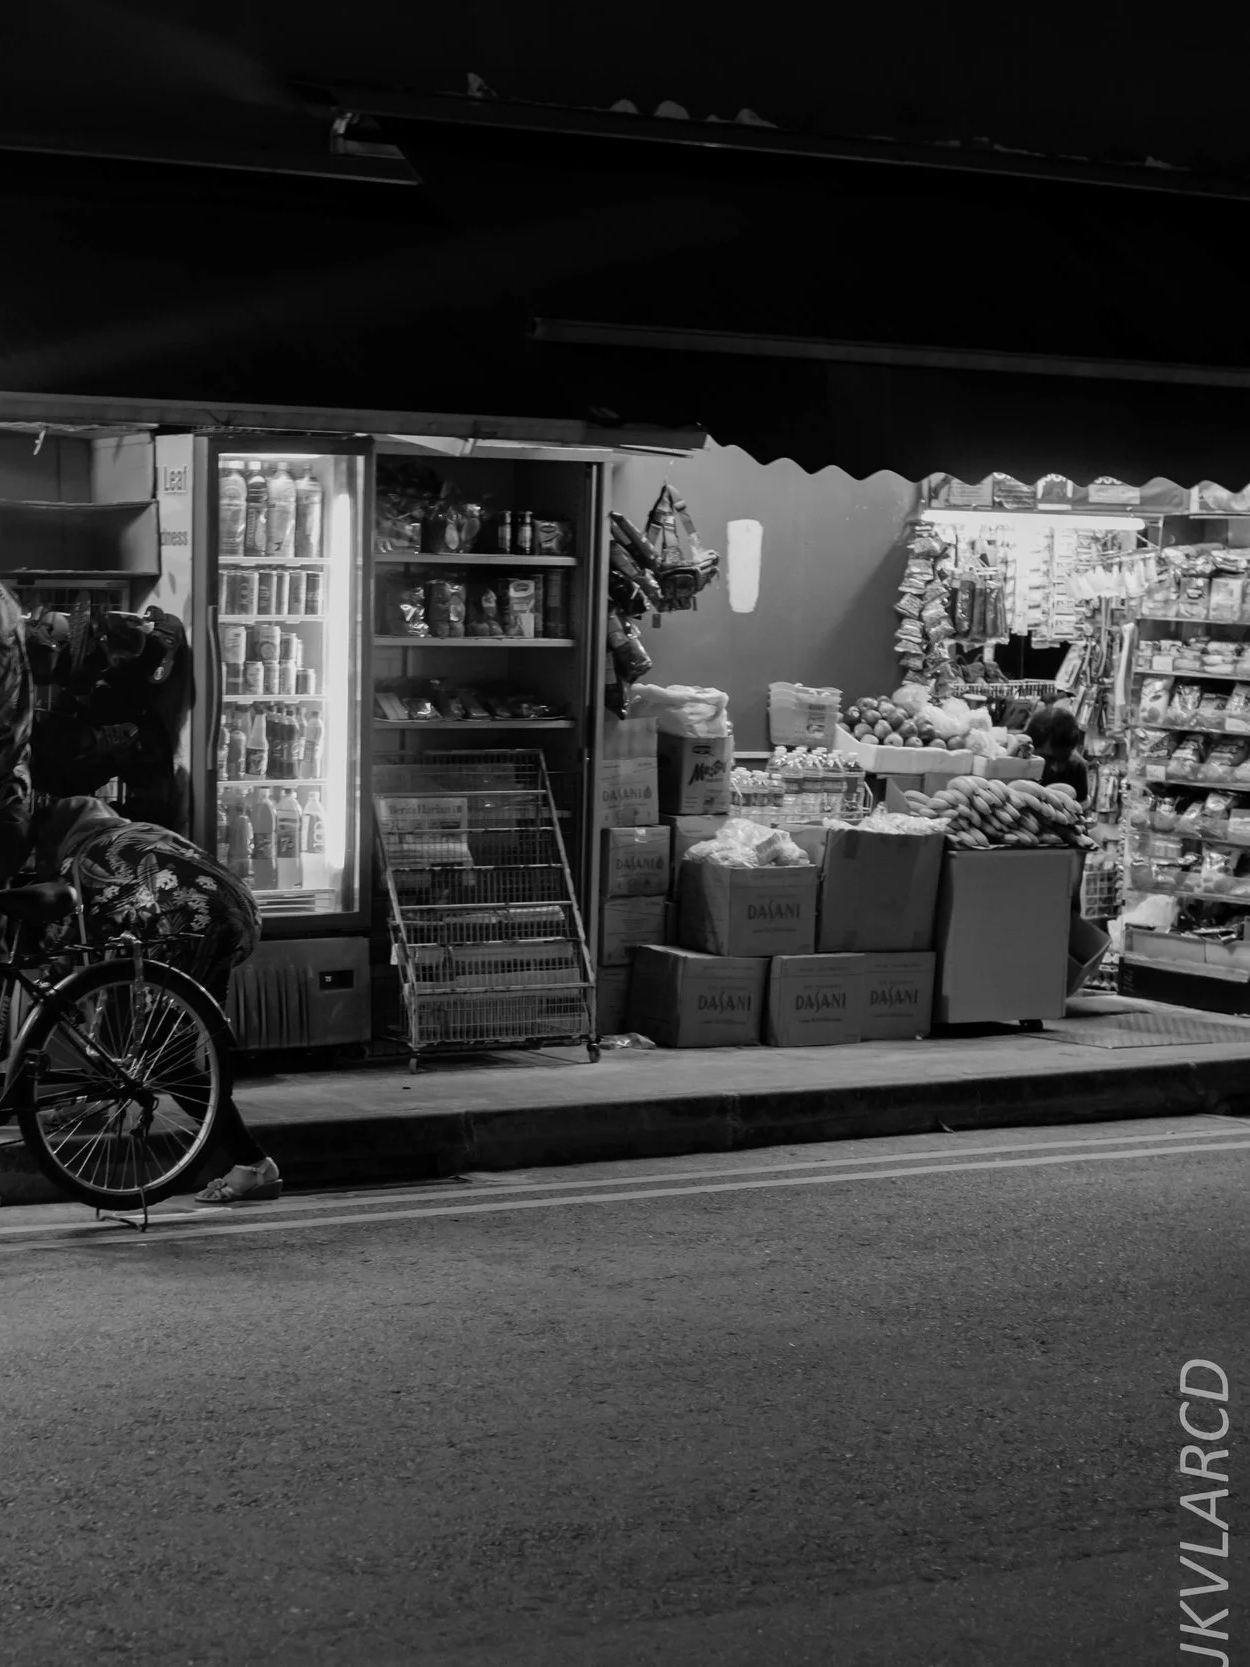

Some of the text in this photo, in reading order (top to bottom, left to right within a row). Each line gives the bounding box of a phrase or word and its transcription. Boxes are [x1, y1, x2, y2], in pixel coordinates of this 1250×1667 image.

[747, 900, 801, 924] DASANI
[698, 991, 751, 1014] DASANI
[795, 990, 847, 1013] DASANI
[870, 985, 919, 1008] DASANI
